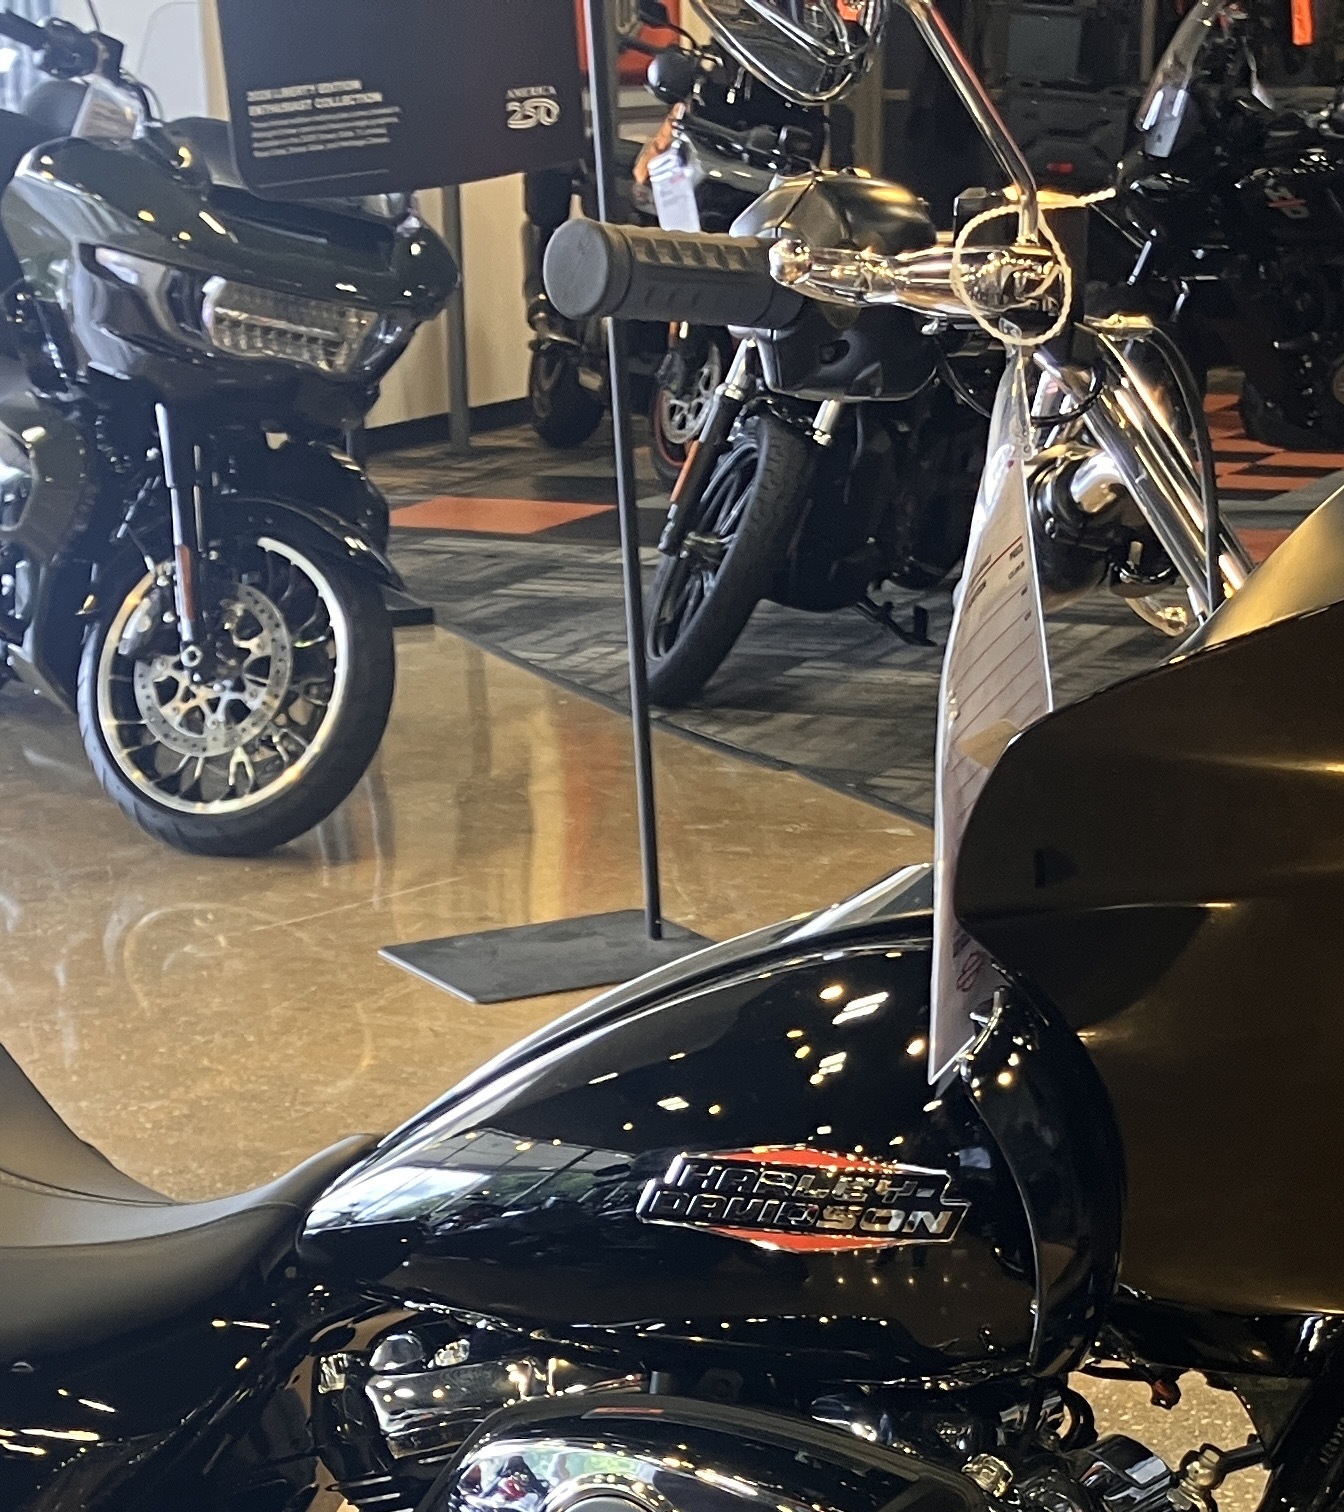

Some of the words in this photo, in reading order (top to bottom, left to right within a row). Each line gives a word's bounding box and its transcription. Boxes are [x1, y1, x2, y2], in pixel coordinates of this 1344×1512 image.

[505, 97, 560, 129] 250
[676, 1162, 936, 1205] HARLEY-
[648, 1188, 953, 1235] DAVIDSON
